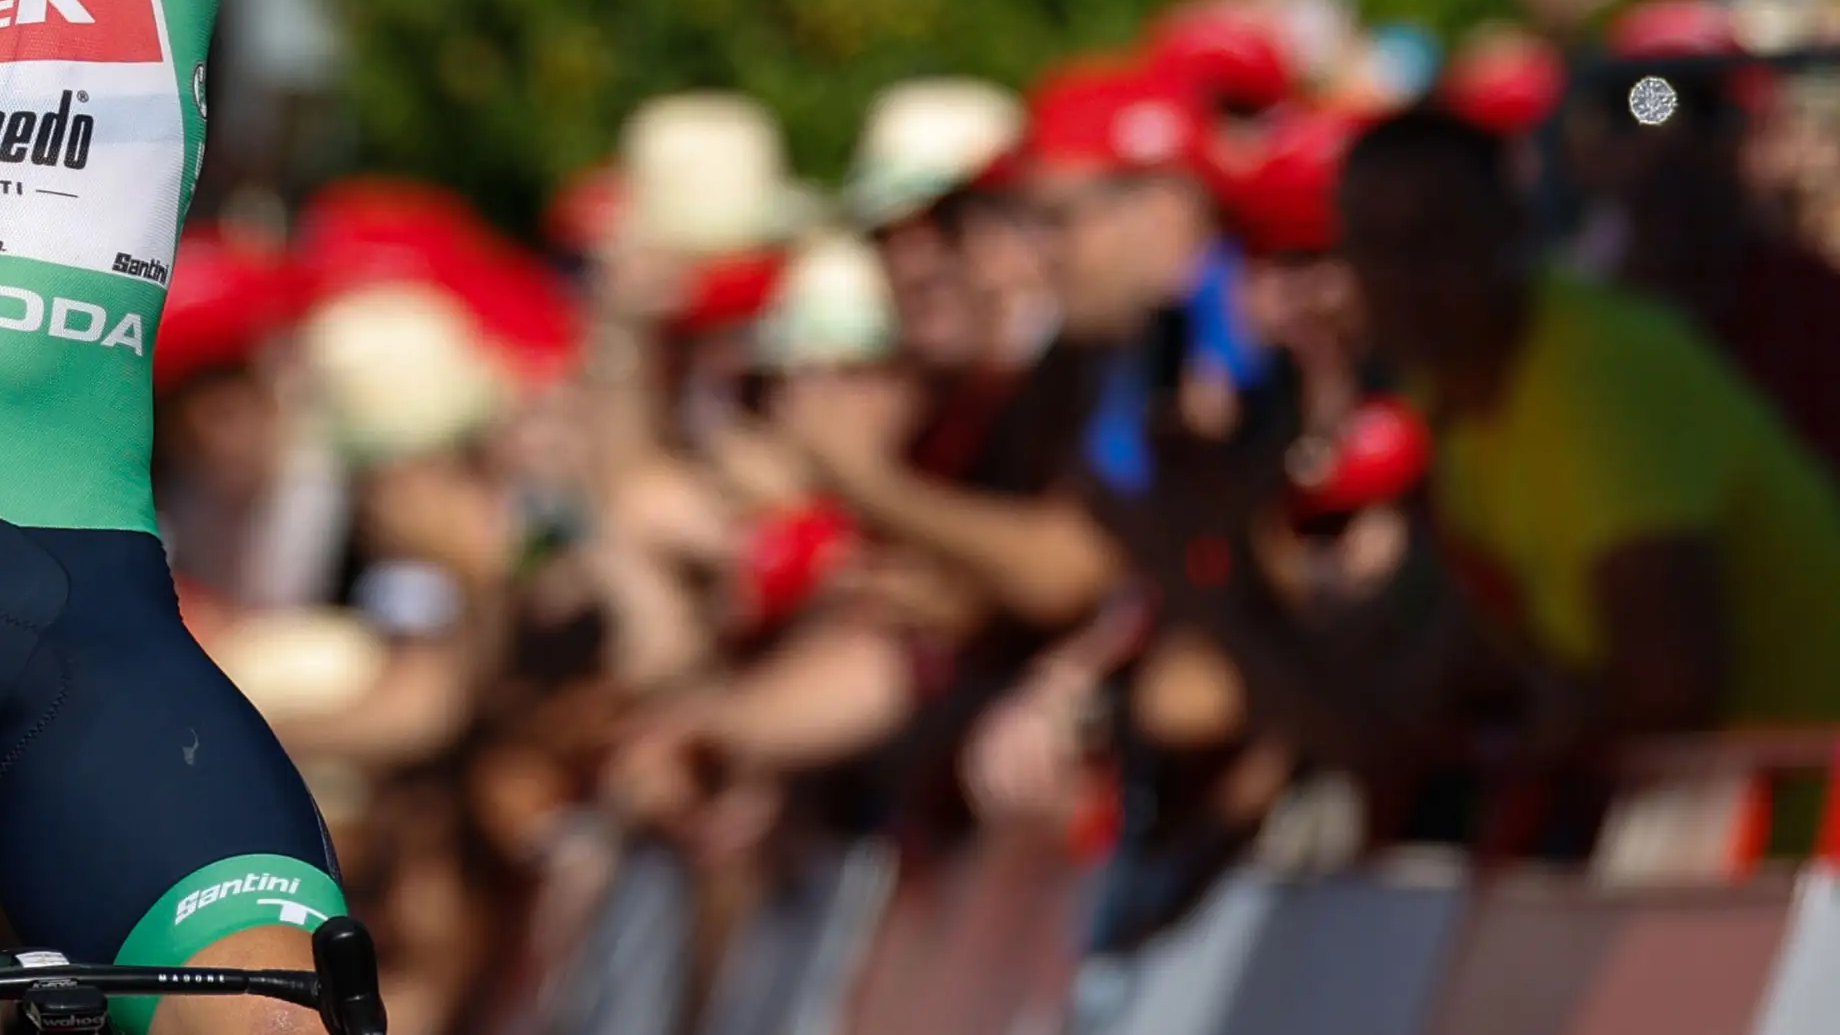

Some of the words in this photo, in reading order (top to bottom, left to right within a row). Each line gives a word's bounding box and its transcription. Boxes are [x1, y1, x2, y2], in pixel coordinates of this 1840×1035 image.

[112, 251, 169, 286] Santini
[174, 872, 301, 925] Santini
[158, 973, 225, 983] MADONE
